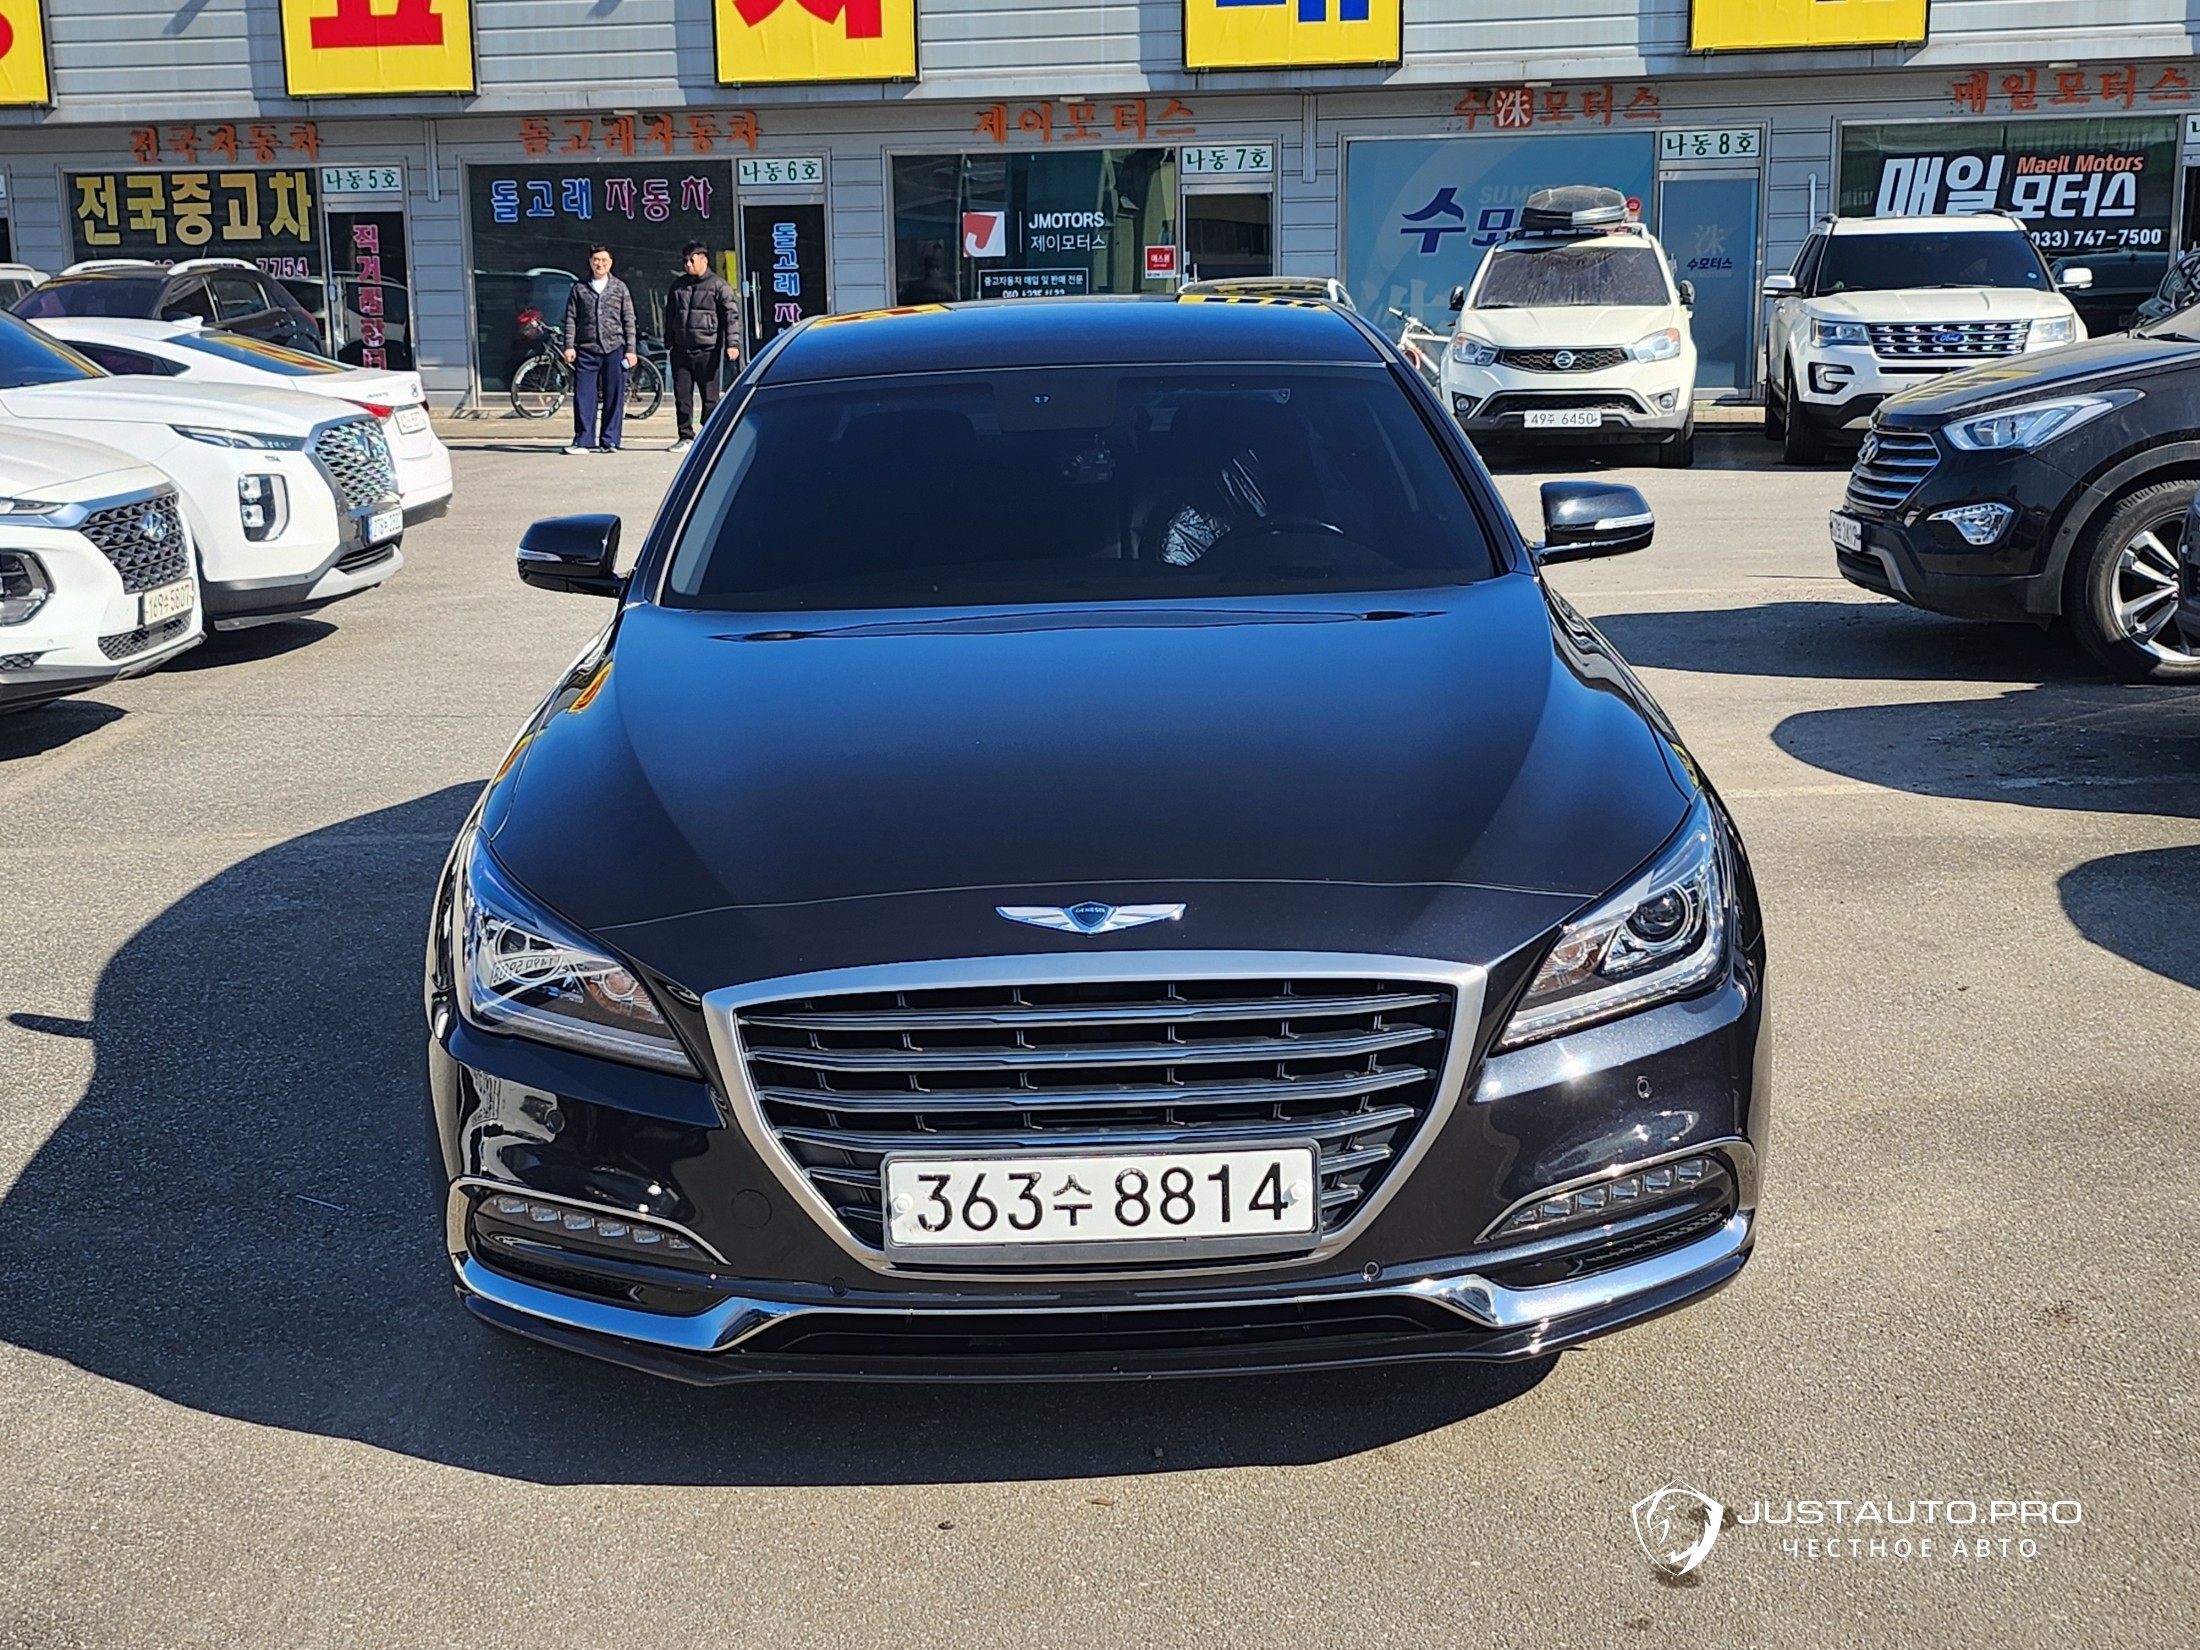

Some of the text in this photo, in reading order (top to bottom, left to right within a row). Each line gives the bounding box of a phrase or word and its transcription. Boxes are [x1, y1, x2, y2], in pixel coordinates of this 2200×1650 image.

[1952, 65, 2191, 113] 매일모터스
[129, 123, 323, 165] 전국자동차
[519, 111, 763, 155] 돌고래자동차
[973, 100, 1196, 144] 제이모터스
[1875, 153, 2137, 220] 매일 모터스
[2016, 155, 2144, 174] Maeil Motors
[75, 171, 313, 246] 전국중고차
[490, 175, 714, 223] 돌고래 자동차
[1028, 212, 1105, 229] JMOTORS
[772, 223, 800, 296] 돌고래
[1030, 234, 1107, 252] 제이모터스
[2073, 228, 2161, 248] 747-7500
[1687, 257, 1733, 271] 수모터스
[1561, 412, 1594, 425] 6450
[916, 1161, 1289, 1232] 363수 8814
